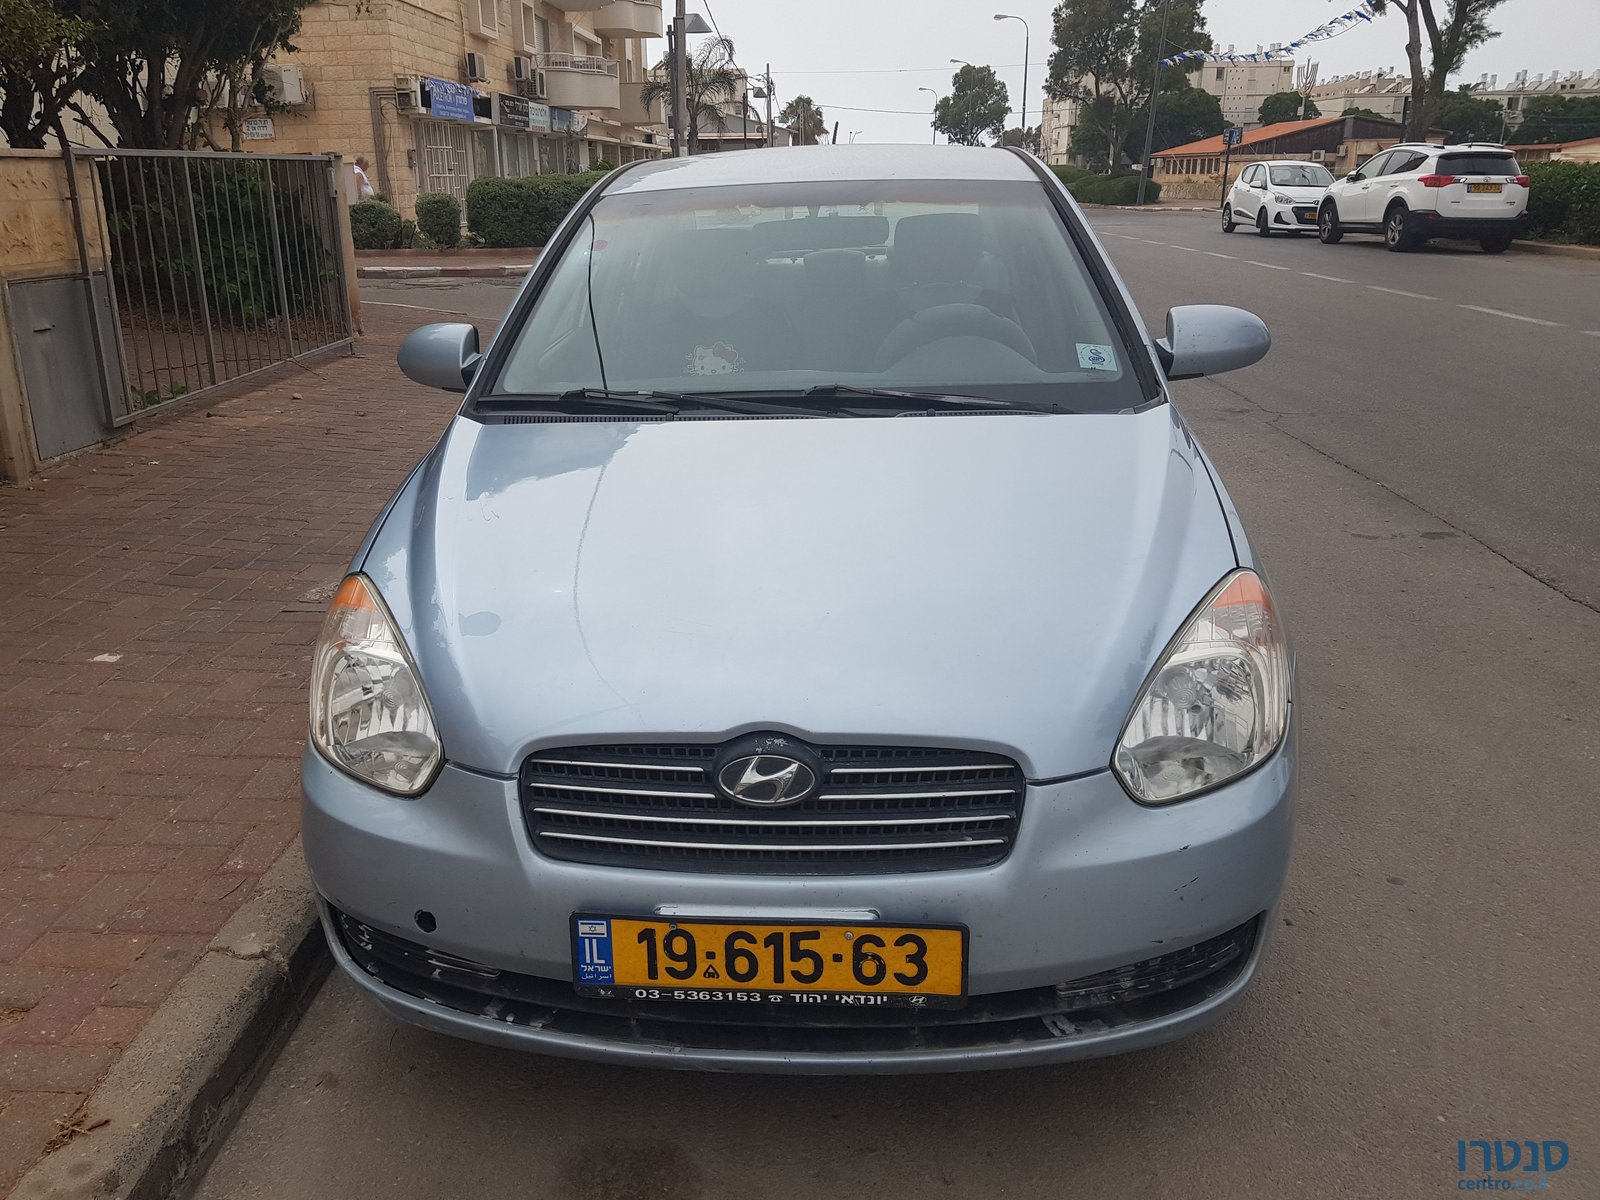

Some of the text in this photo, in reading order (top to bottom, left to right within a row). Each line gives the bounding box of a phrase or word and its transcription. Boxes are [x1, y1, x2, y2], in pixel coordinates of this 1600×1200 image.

[584, 938, 606, 964] IL
[580, 964, 612, 973] ישראל
[634, 988, 888, 1006] יונדאי יהוד 03-5363153
